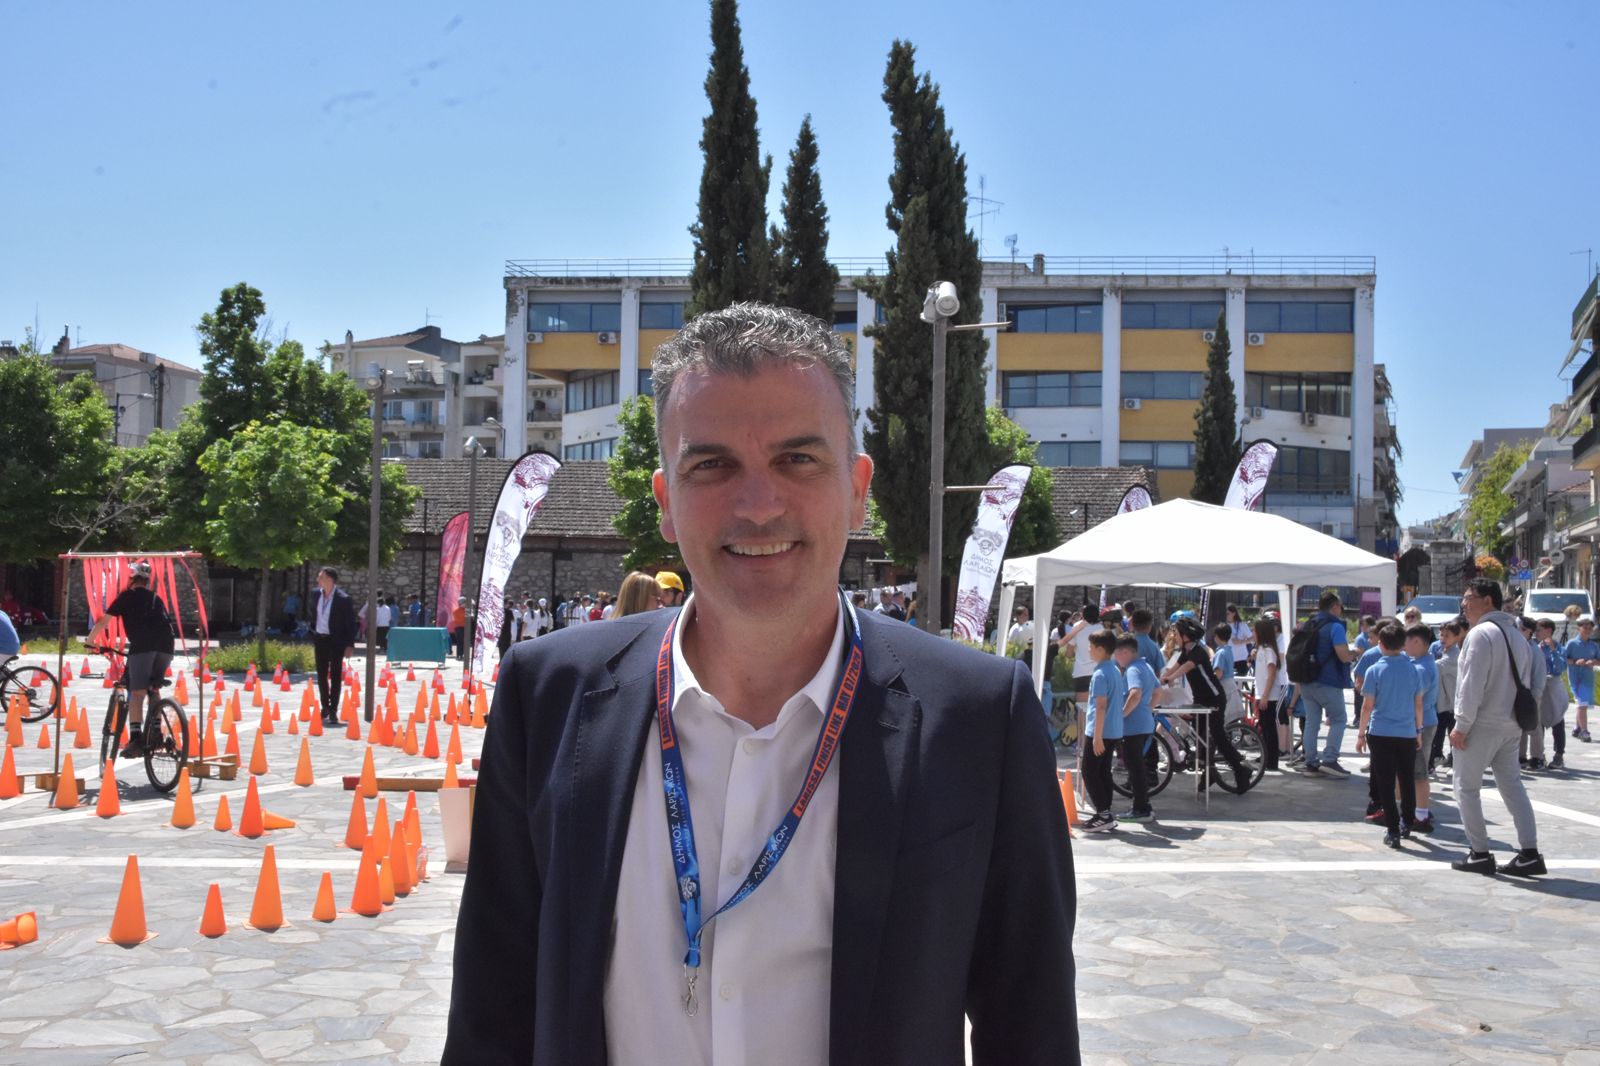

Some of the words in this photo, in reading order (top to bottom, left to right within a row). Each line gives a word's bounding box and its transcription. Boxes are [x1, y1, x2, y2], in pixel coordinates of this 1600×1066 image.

[659, 669, 670, 700] FINISH
[797, 768, 821, 811] LARISSA
[817, 734, 835, 769] FINISH
[828, 711, 844, 736] LINE
[837, 691, 852, 712] MAY
[672, 822, 685, 863] ΔΗΜΟΣ
